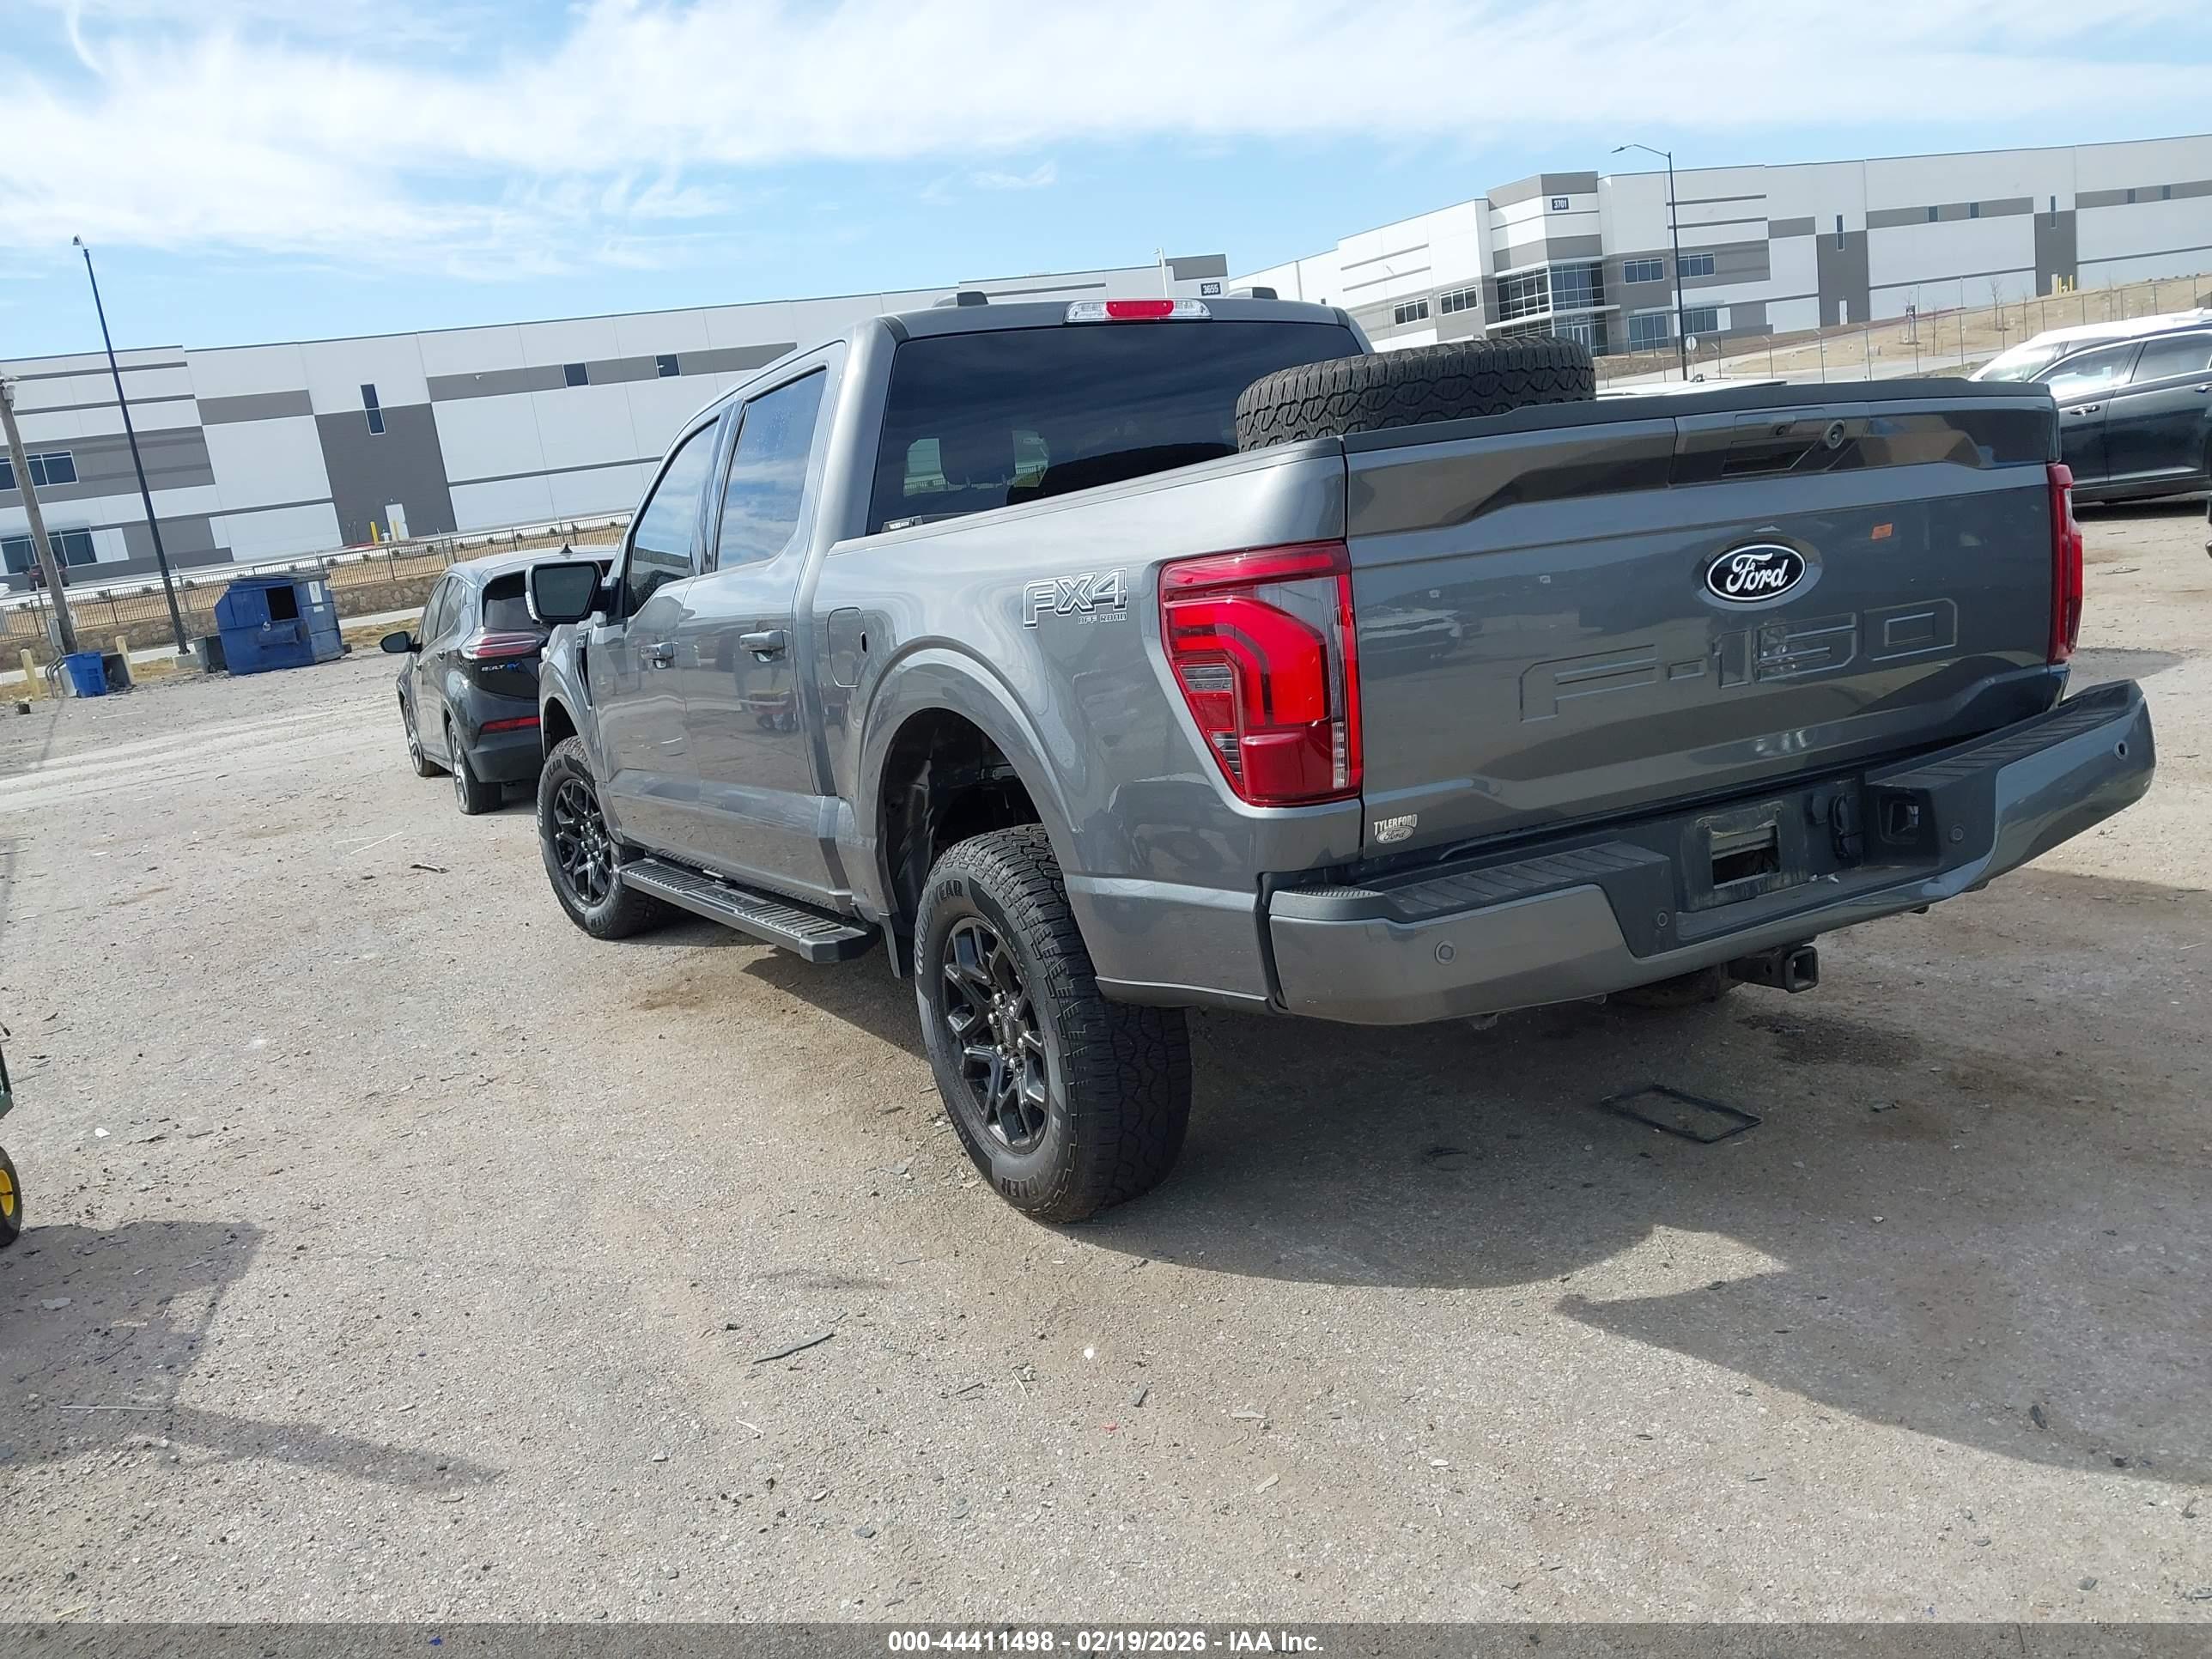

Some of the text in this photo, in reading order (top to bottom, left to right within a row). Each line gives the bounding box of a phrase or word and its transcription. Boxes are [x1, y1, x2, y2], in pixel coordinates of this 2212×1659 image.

[1553, 198, 1567, 209] 3701
[1202, 283, 1218, 295] 3655
[1726, 552, 1789, 592] Ford
[1023, 567, 1127, 629] FX4
[1078, 612, 1127, 624] OFF ROAD
[1519, 597, 1959, 723] F-150
